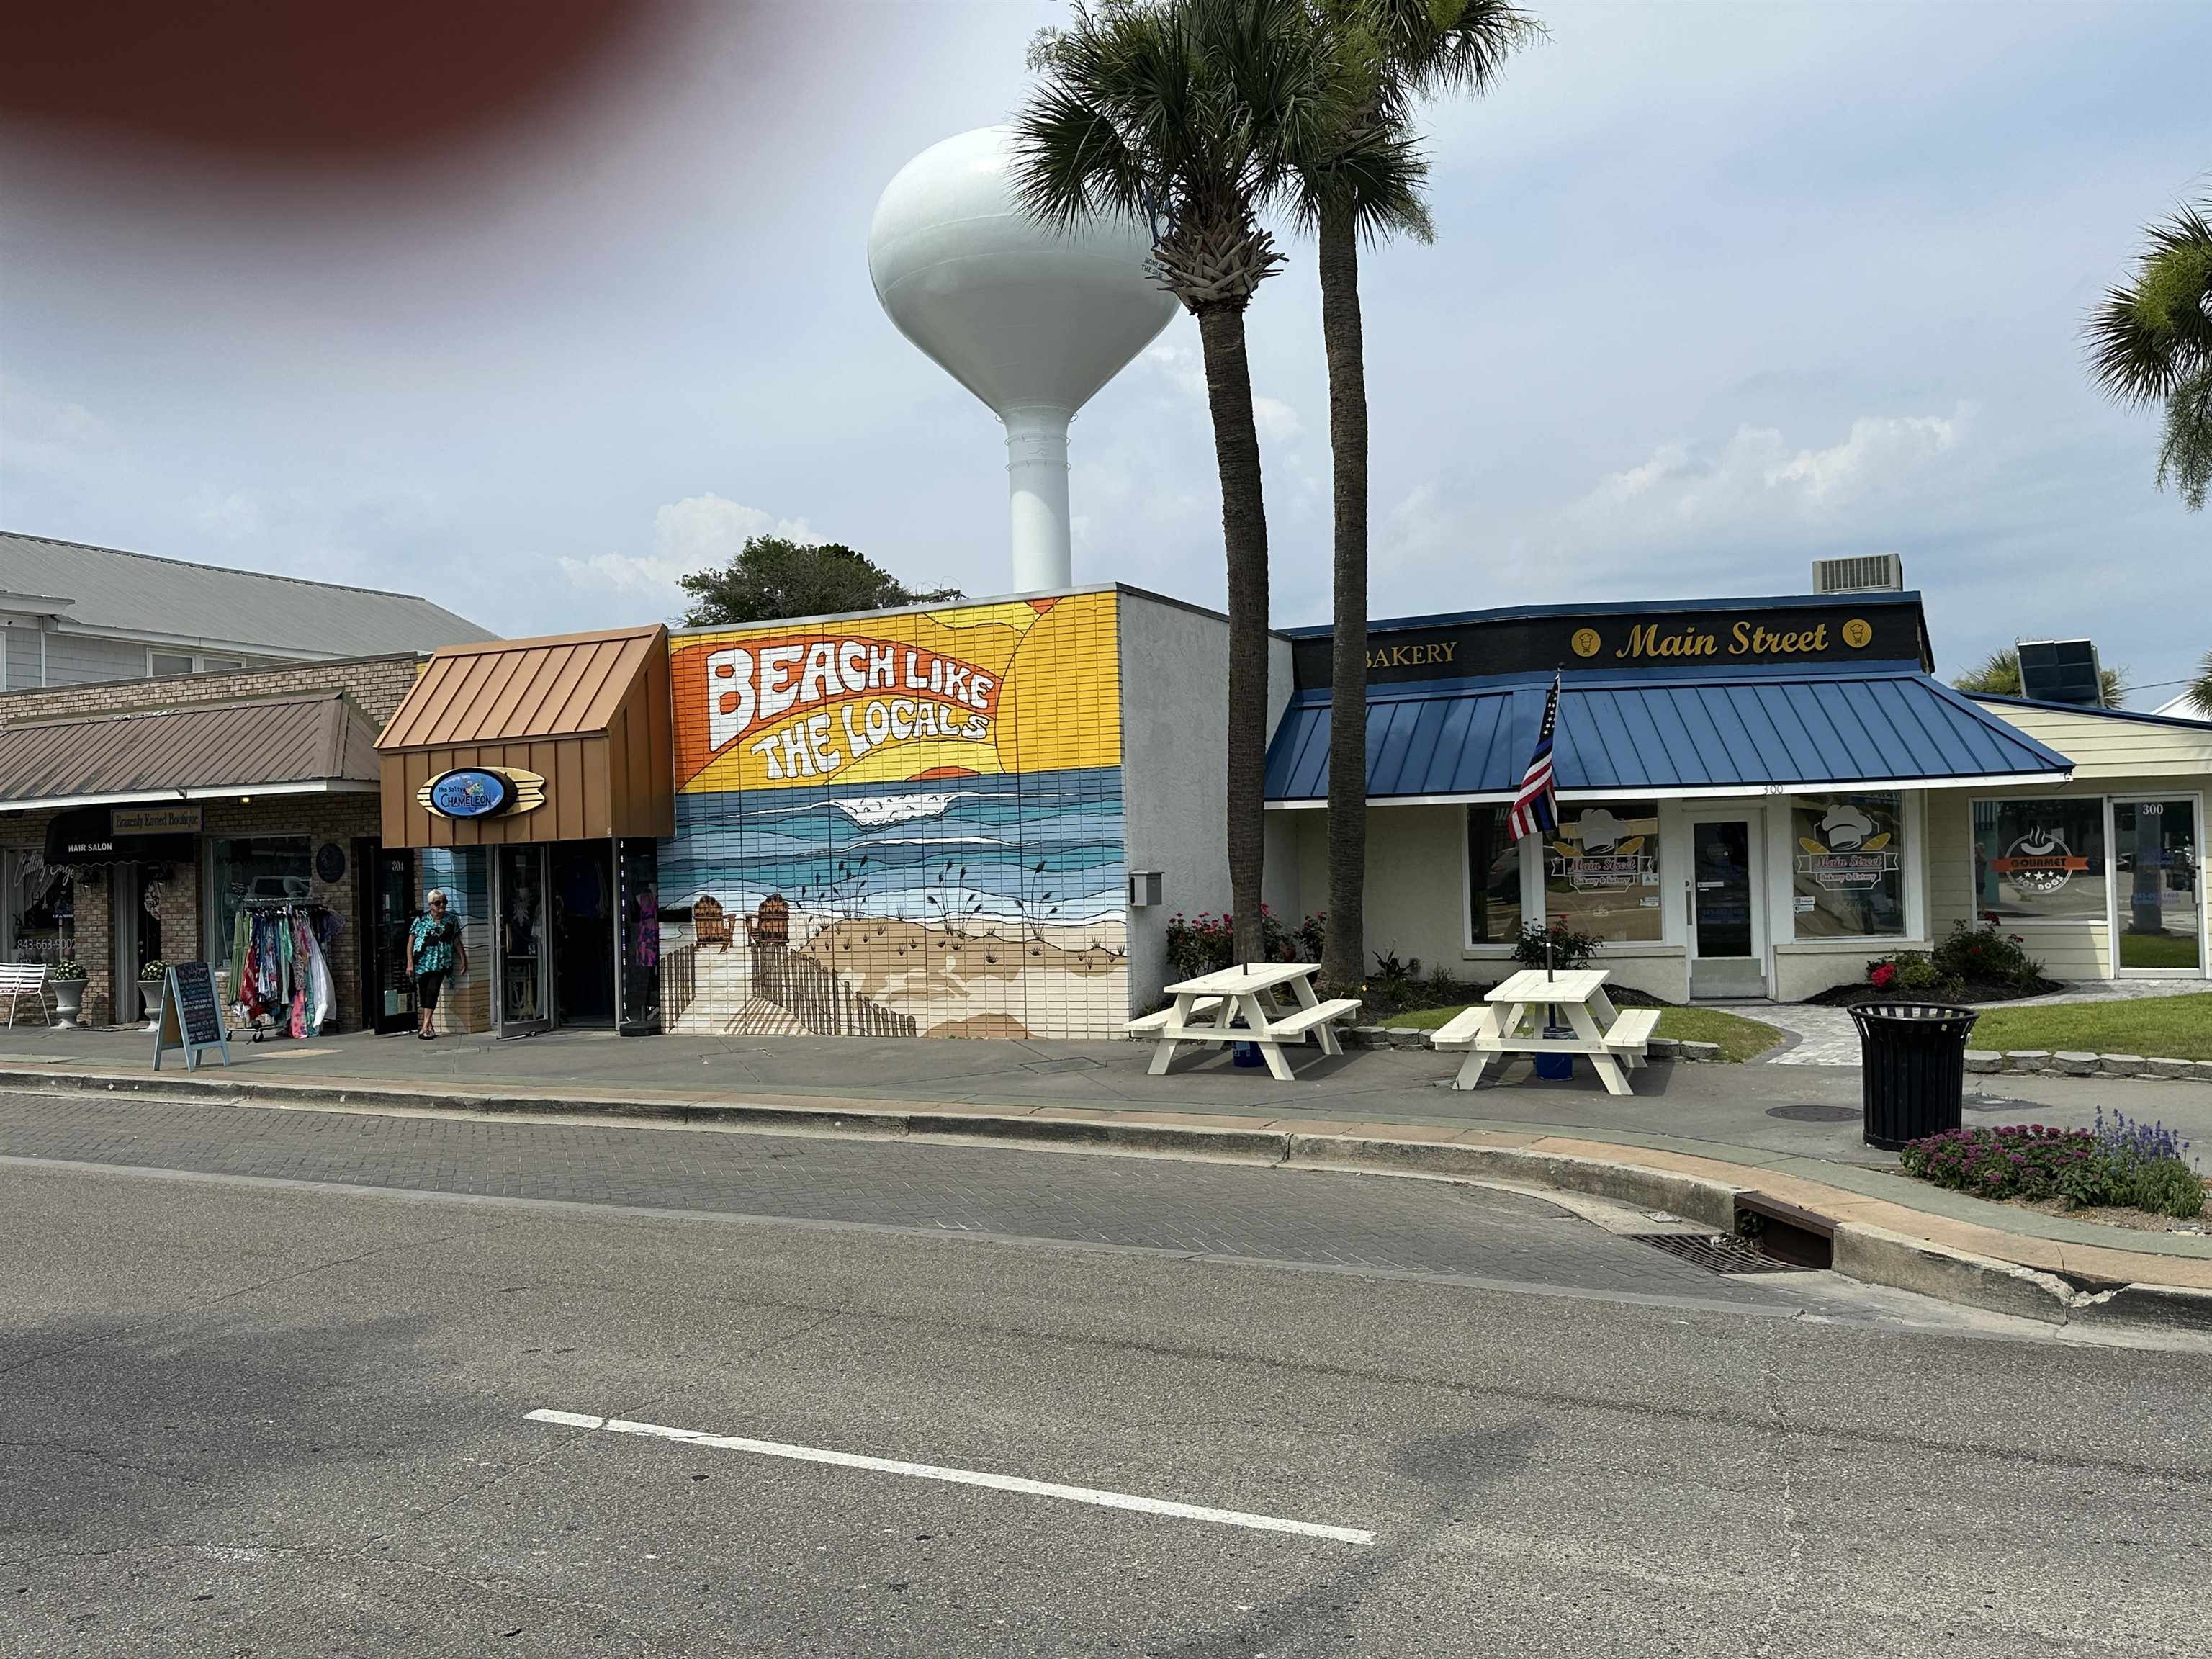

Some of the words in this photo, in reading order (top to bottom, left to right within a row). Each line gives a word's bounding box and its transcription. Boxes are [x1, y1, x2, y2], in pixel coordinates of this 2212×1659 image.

[1616, 624, 1718, 657] Main
[1728, 621, 1828, 654] Street
[706, 640, 899, 753] BEACH
[904, 650, 994, 710] LIKE
[750, 713, 842, 780] THE
[841, 699, 990, 758] LOCALS
[440, 792, 492, 807] CHAMELEON
[2142, 804, 2164, 815] 300
[68, 844, 86, 853] HAIR
[88, 842, 112, 852] SALON
[1568, 858, 1601, 871] Main
[1817, 855, 1848, 867] Main
[1848, 855, 1883, 867] Street
[2010, 858, 2067, 868] GOURMET
[2017, 875, 2035, 889] HOT
[2037, 875, 2064, 891] DOGS
[17, 938, 76, 950] 843-663-9002
